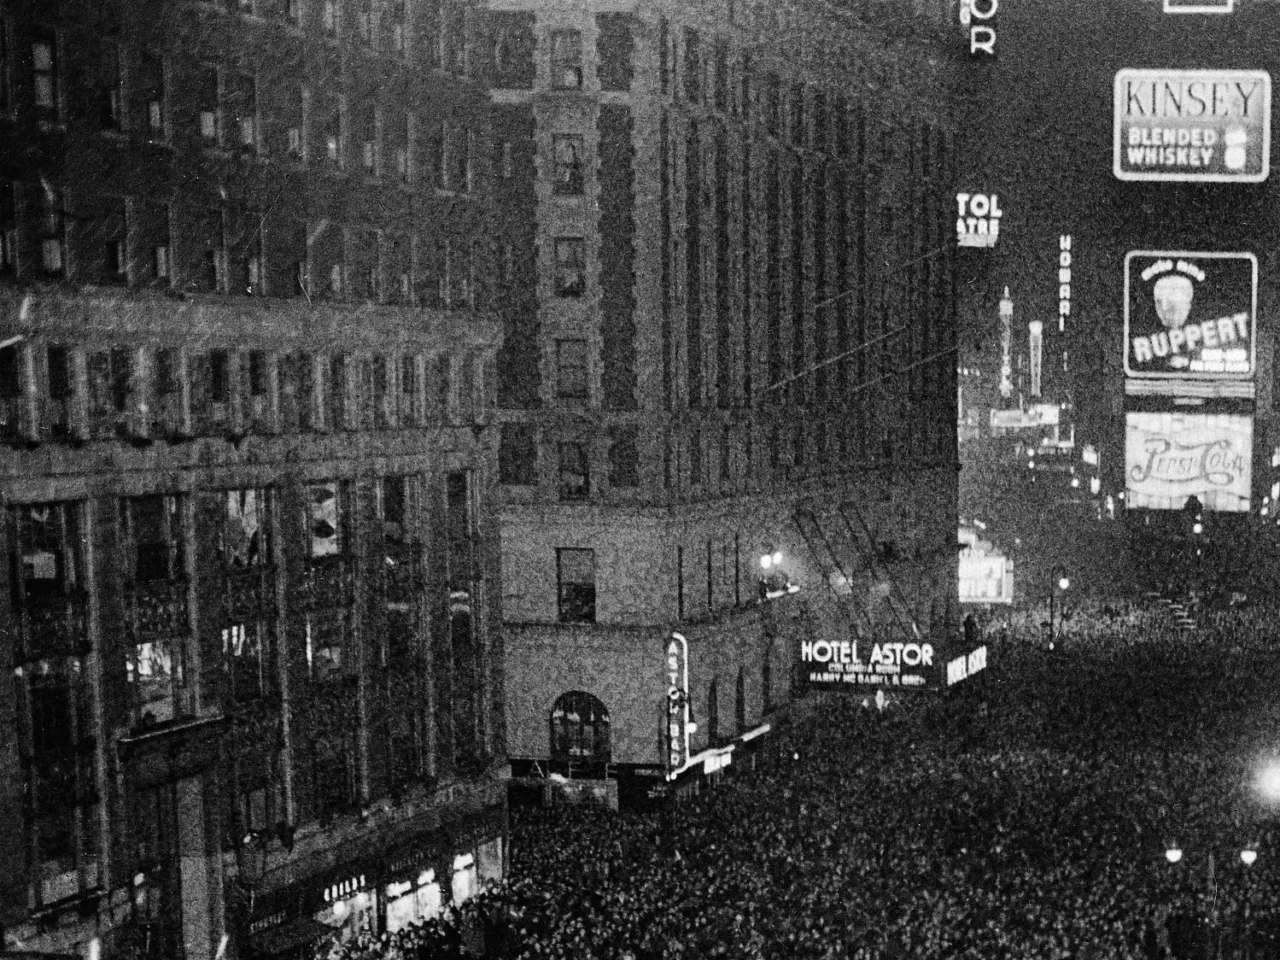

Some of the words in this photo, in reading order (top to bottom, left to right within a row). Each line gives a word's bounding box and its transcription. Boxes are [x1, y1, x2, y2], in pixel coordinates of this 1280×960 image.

[1126, 80, 1260, 117] KINSEY
[1128, 127, 1217, 146] BLENDED
[1127, 147, 1215, 166] WHISKEY
[1133, 311, 1249, 362] RUPPERT
[801, 640, 862, 664] HOTEL
[870, 642, 934, 666] ASTOR
